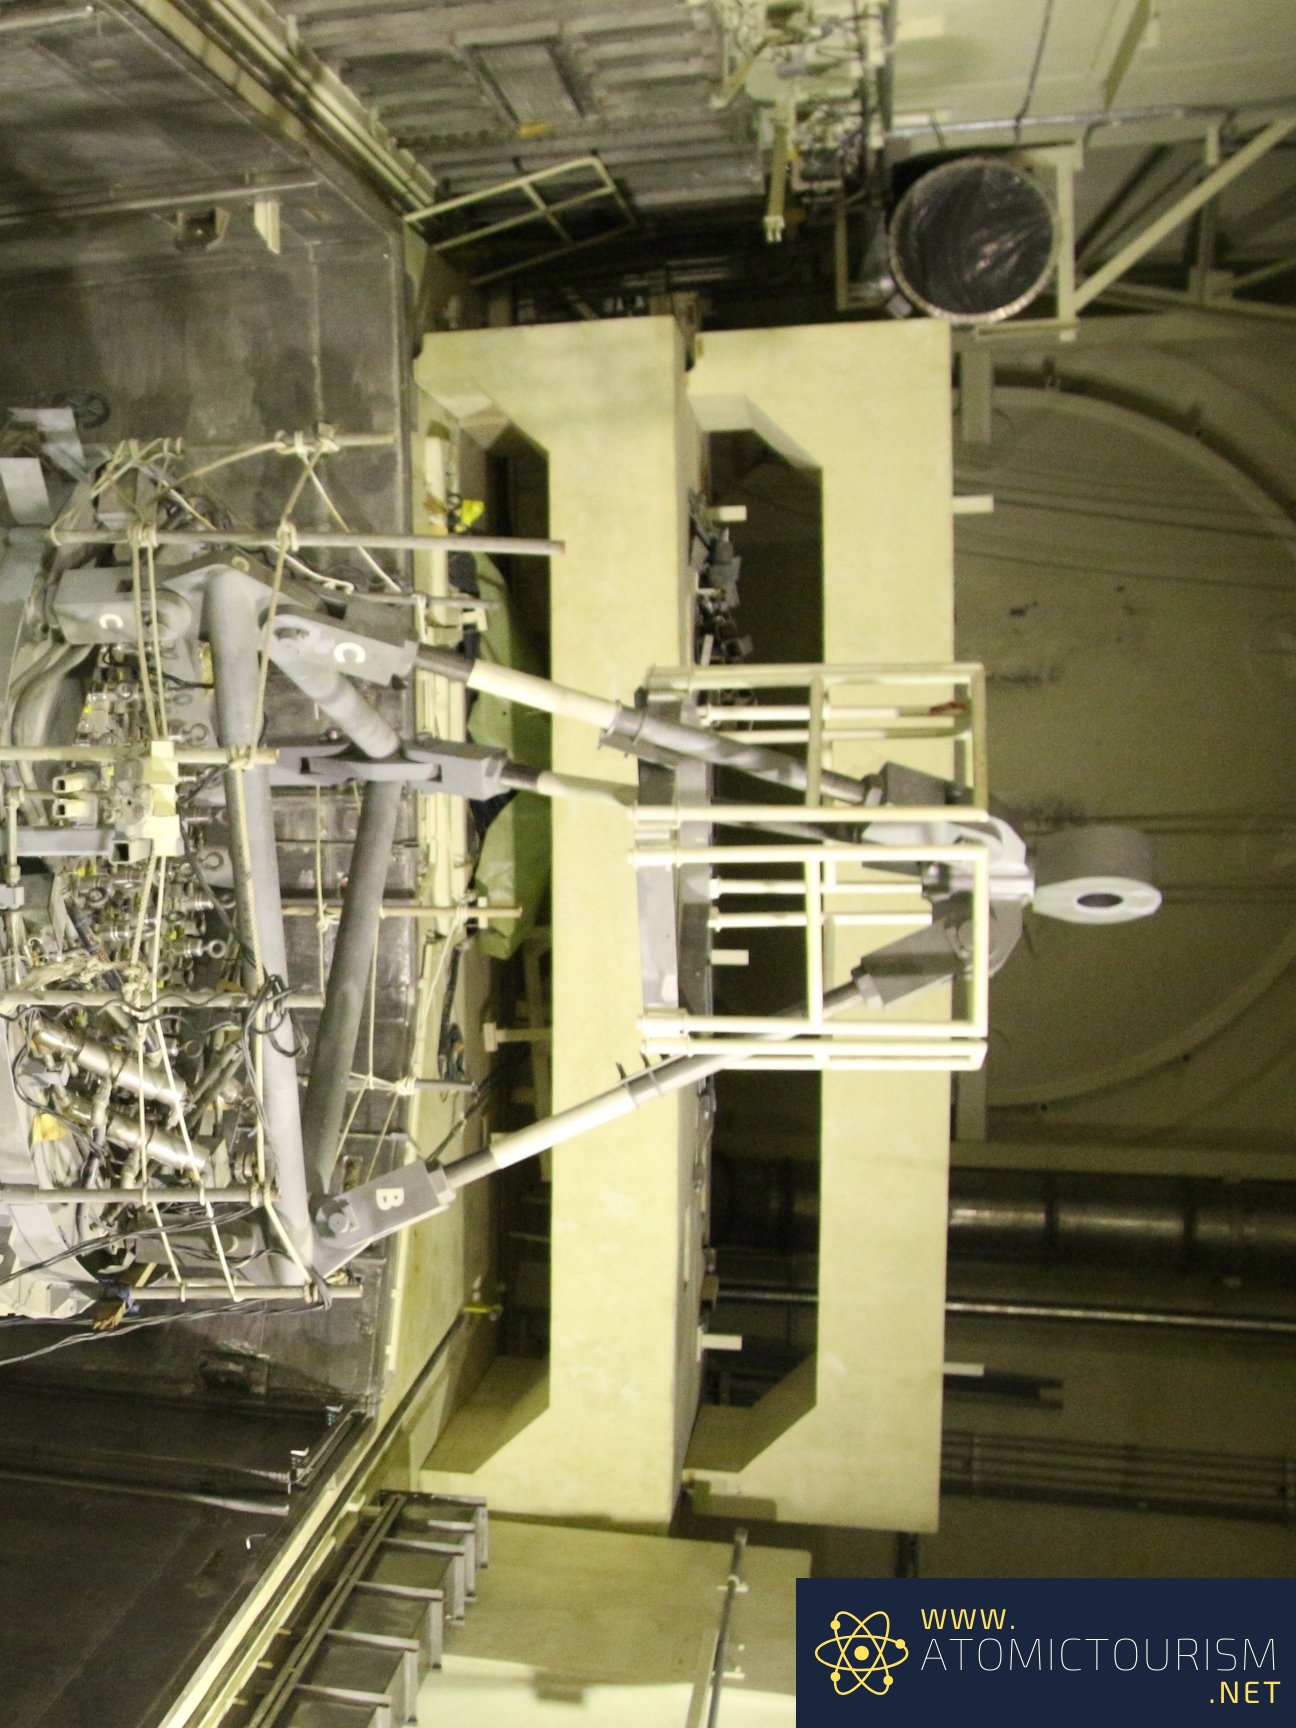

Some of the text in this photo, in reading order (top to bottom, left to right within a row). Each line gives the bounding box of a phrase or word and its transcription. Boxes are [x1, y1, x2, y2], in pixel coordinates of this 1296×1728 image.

[99, 613, 124, 629] C
[333, 642, 366, 664] C
[376, 1187, 405, 1212] B
